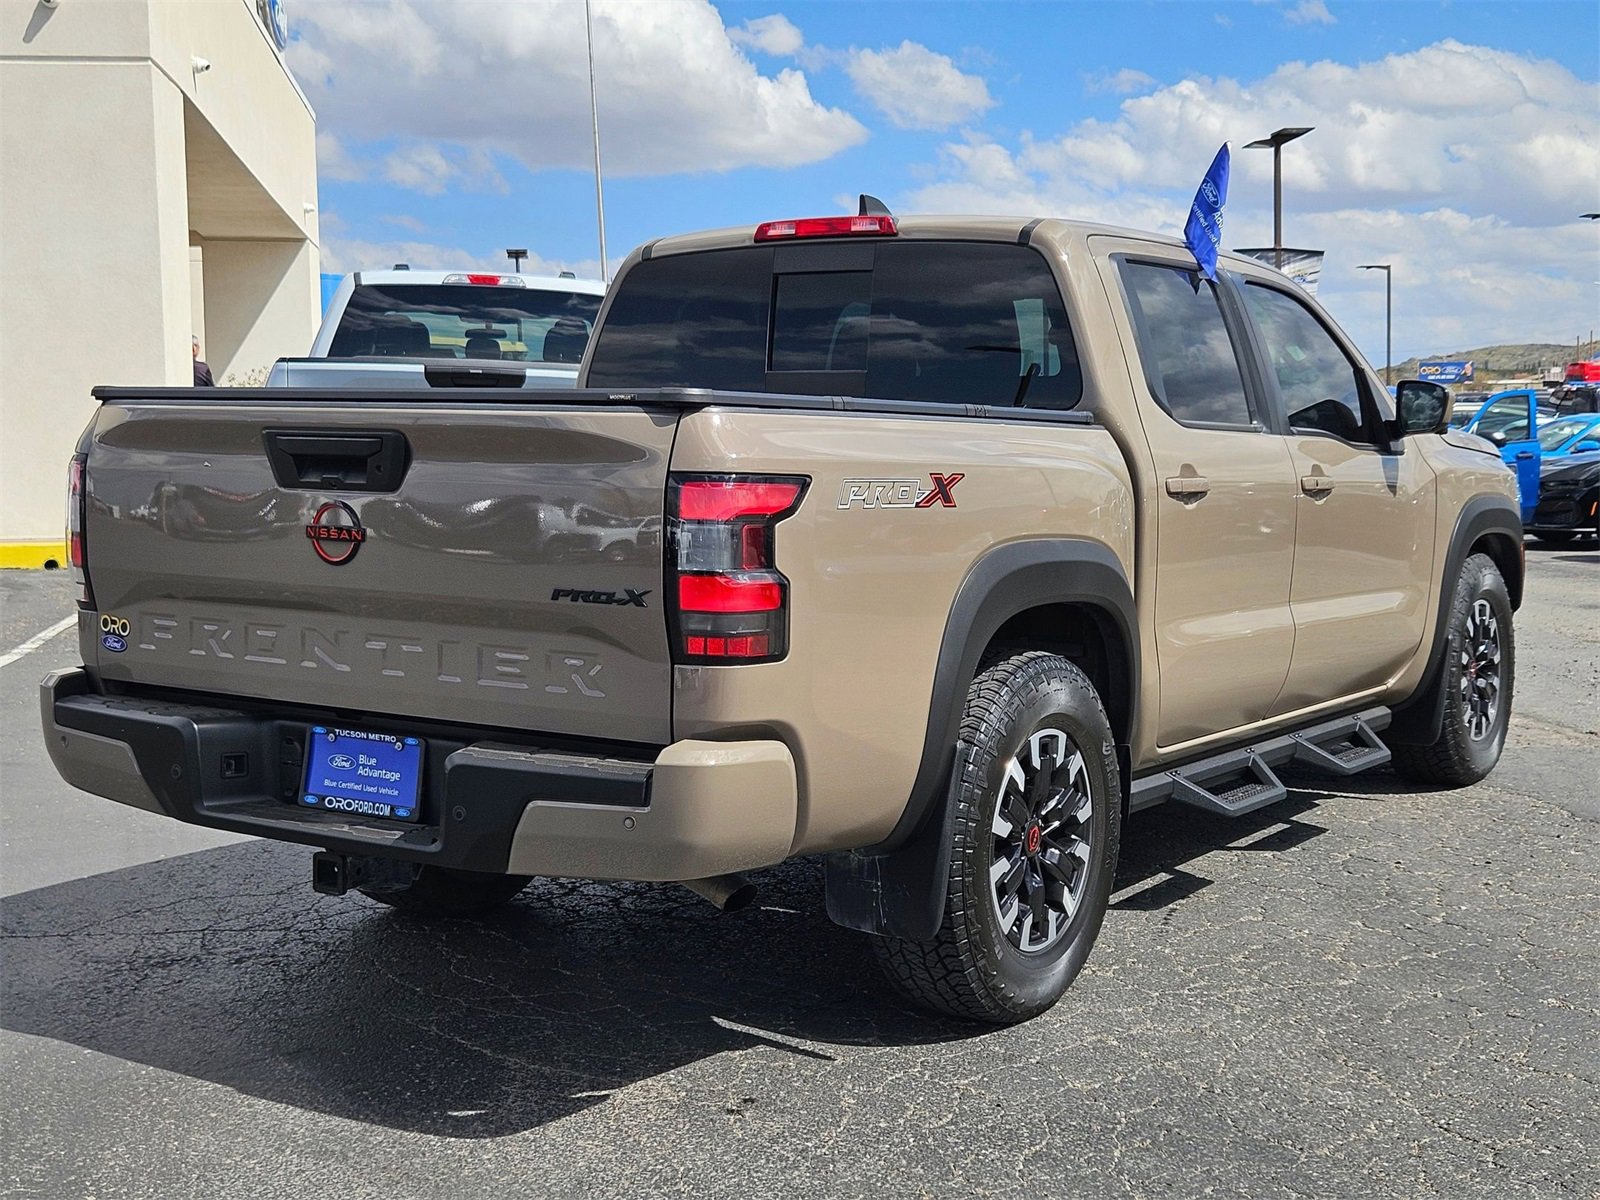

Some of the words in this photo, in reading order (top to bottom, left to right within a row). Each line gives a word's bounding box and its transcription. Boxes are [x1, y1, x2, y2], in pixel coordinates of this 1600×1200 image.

[1201, 181, 1218, 204] Ford
[1205, 226, 1218, 244] Used
[1420, 366, 1441, 375] ORO
[307, 527, 362, 540] NISSAN
[100, 614, 130, 636] ORO
[104, 636, 124, 650] Ford
[138, 611, 606, 698] FRONTIER
[335, 729, 367, 739] TUCSON
[368, 733, 397, 743] METRO
[331, 755, 353, 769] Ford
[359, 754, 377, 766] Blue
[357, 766, 401, 781] Advantage
[324, 778, 338, 788] Blue
[338, 780, 362, 791] Certified
[363, 783, 378, 793] Used
[379, 785, 400, 796] Vehicle
[325, 796, 391, 817] OROFORD.COM
